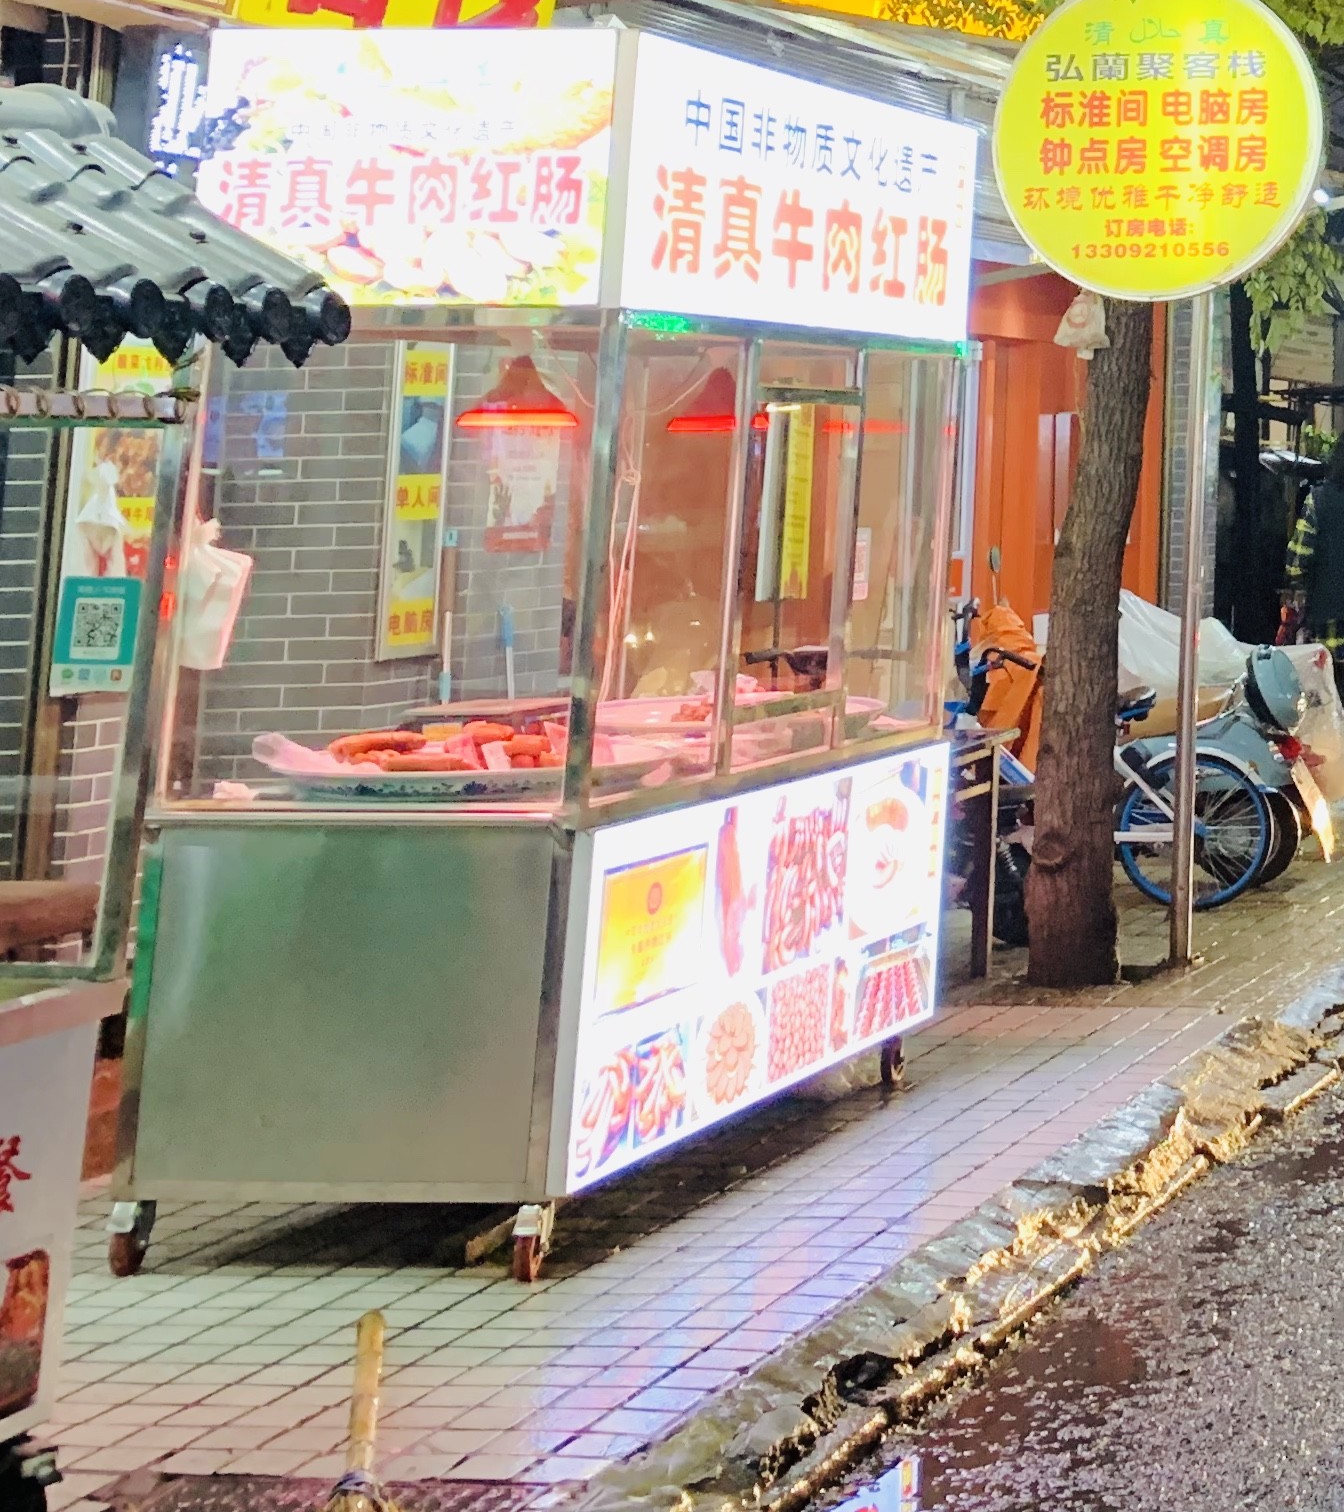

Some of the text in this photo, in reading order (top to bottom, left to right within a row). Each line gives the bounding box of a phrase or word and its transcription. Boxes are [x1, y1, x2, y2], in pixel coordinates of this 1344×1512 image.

[1084, 21, 1114, 46] 清
[1129, 17, 1182, 43] حلال
[1199, 19, 1231, 44] 真
[1160, 87, 1269, 126] 电脑房
[685, 90, 942, 194] 中国非物质文化遗产
[1038, 134, 1269, 177] 钟点房 空调房
[220, 155, 583, 228] 清真牛肉红肠
[1022, 181, 1282, 211] 环境优雅干净舒适
[651, 164, 949, 307] 清真牛肉红肠
[1070, 240, 1231, 260] 13309210556
[404, 359, 447, 386] 标准间
[395, 484, 439, 509] 单人间
